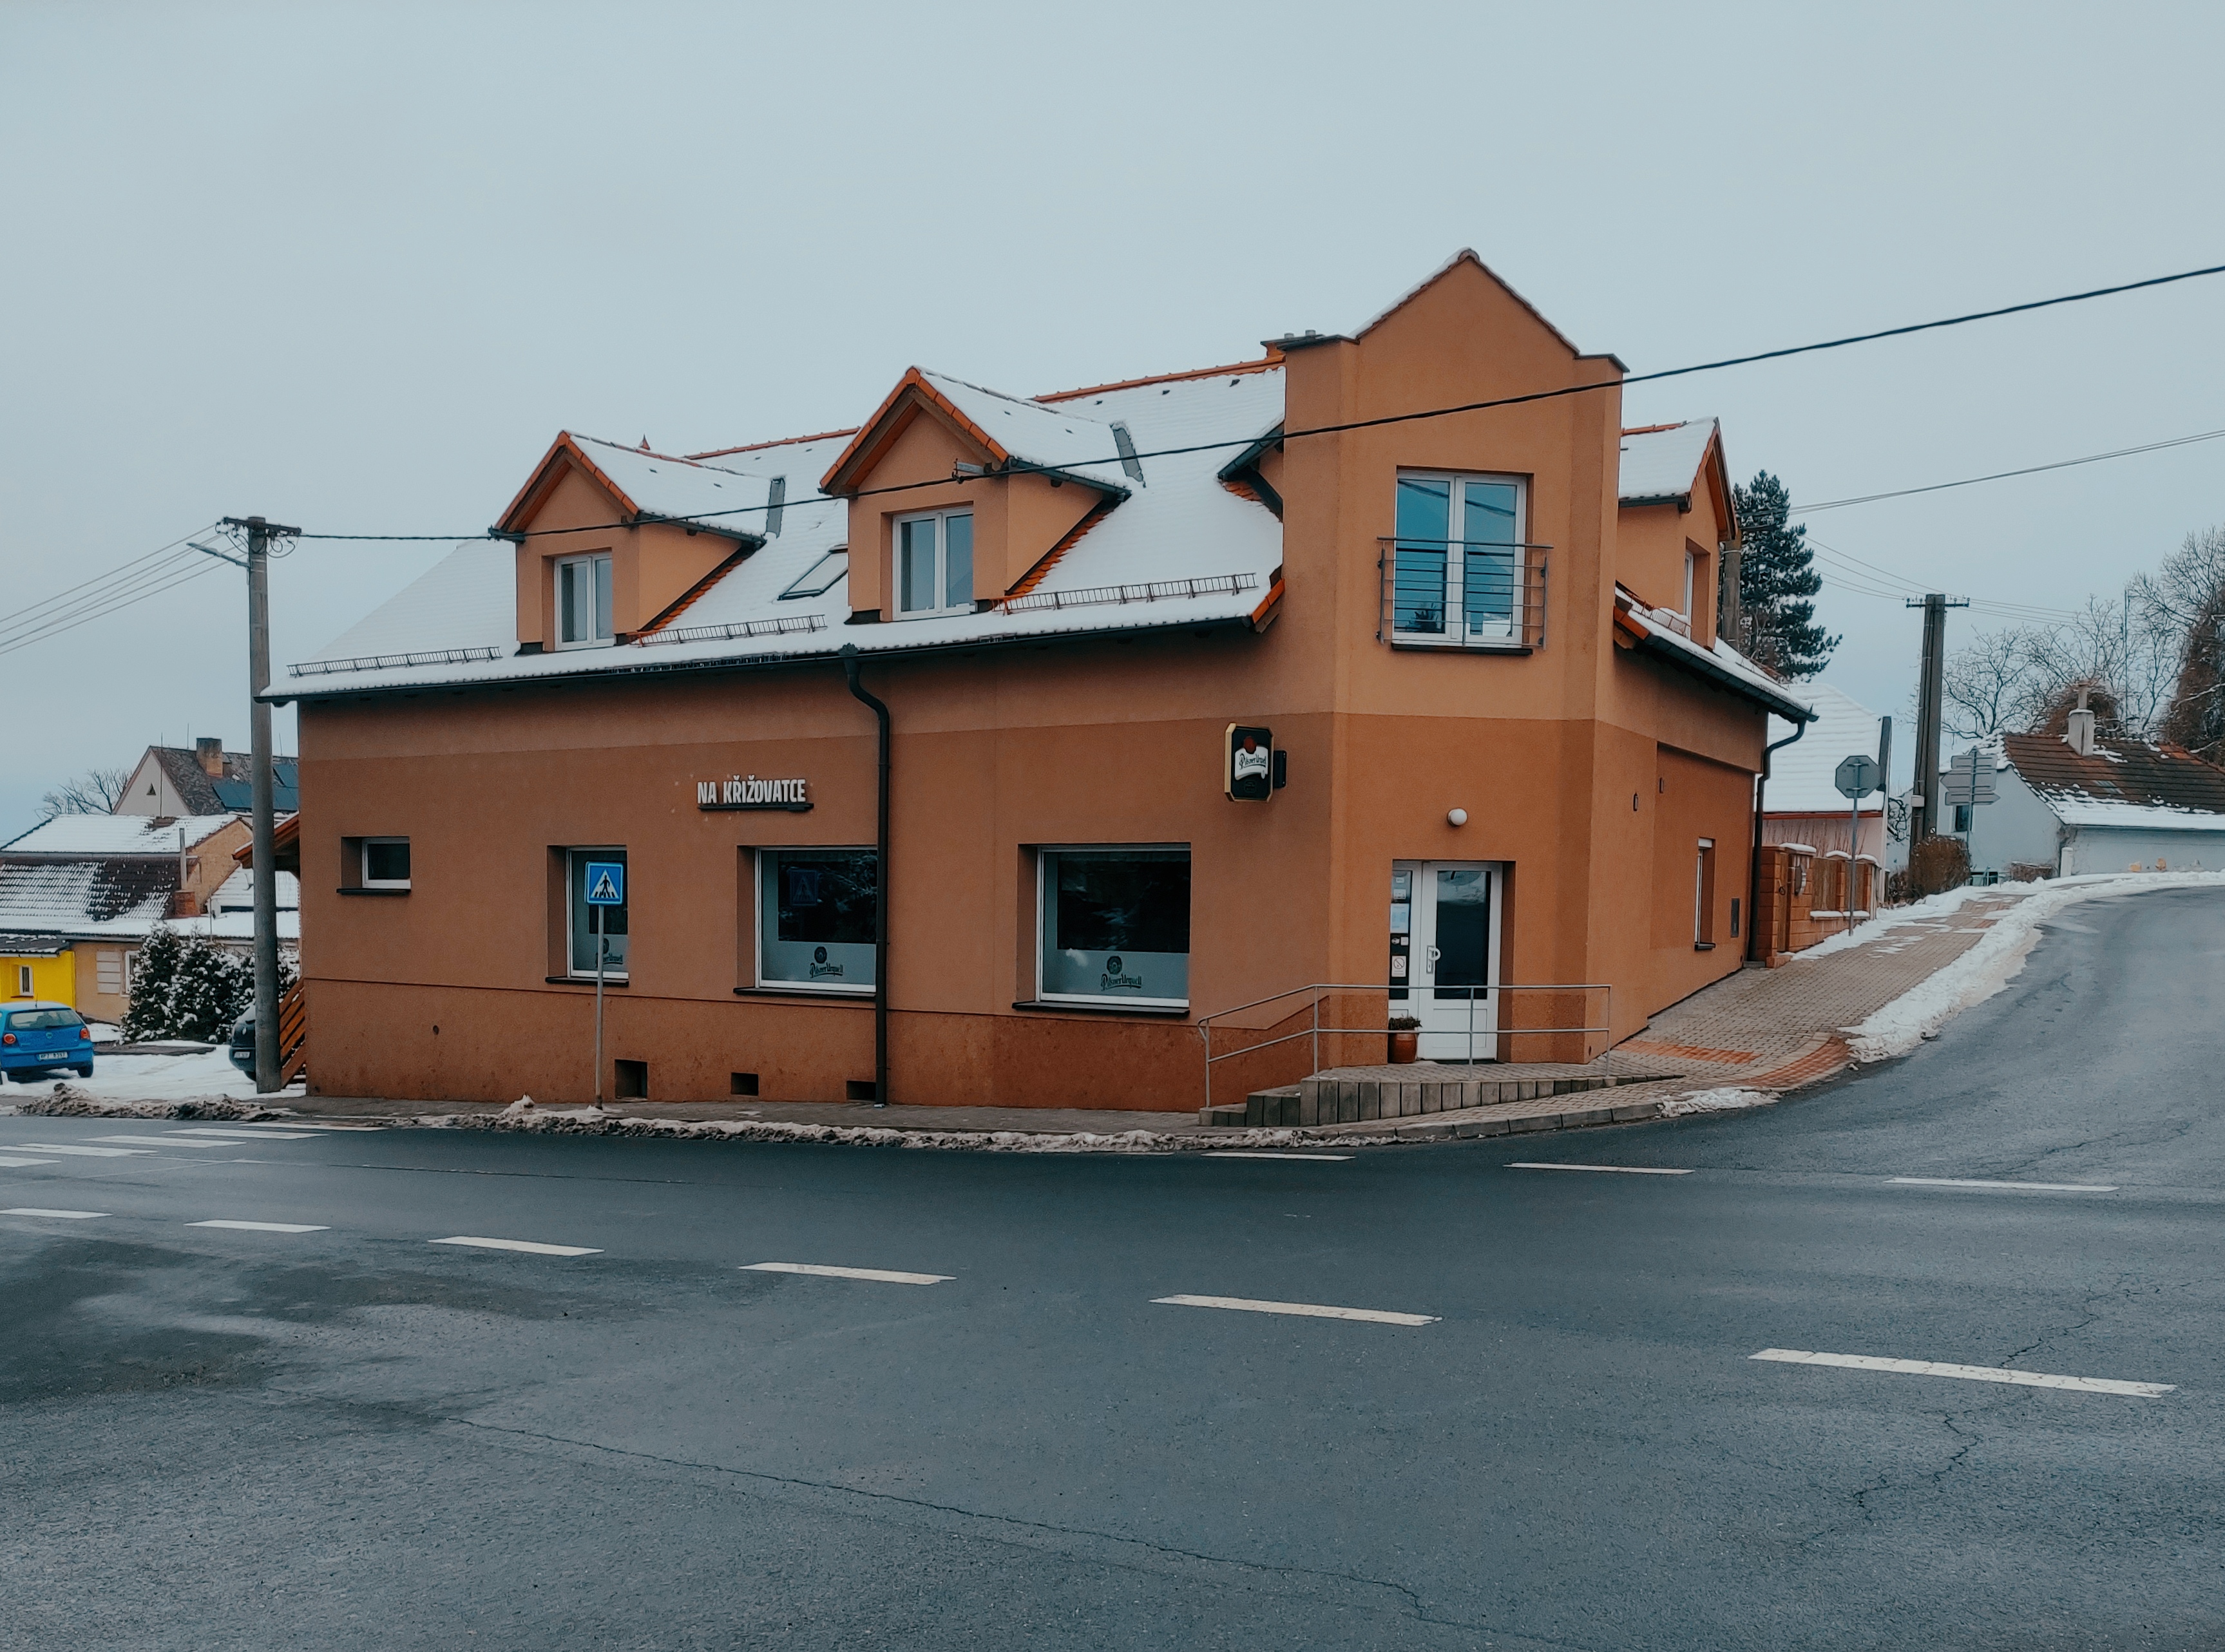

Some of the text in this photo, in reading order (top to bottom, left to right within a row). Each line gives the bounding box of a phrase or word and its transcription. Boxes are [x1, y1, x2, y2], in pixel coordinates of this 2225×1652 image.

[697, 774, 806, 804] NA KŘIŽOVATCE
[1100, 973, 1142, 991] Pilsner Urquell
